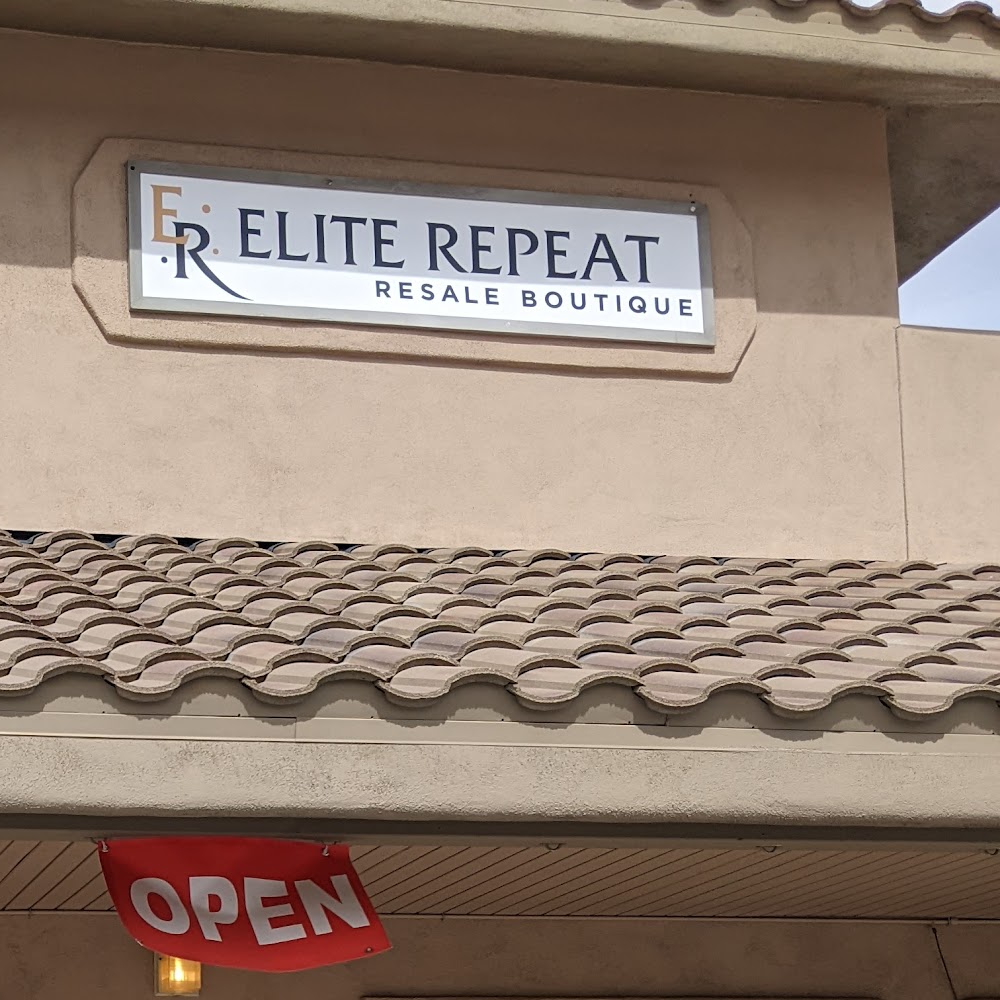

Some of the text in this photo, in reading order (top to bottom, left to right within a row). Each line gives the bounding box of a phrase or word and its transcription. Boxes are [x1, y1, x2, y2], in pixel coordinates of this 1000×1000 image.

[237, 208, 659, 284] ELITE REPEAT
[376, 280, 694, 317] RESALE BOUTIQUE
[130, 873, 370, 946] OPEN
